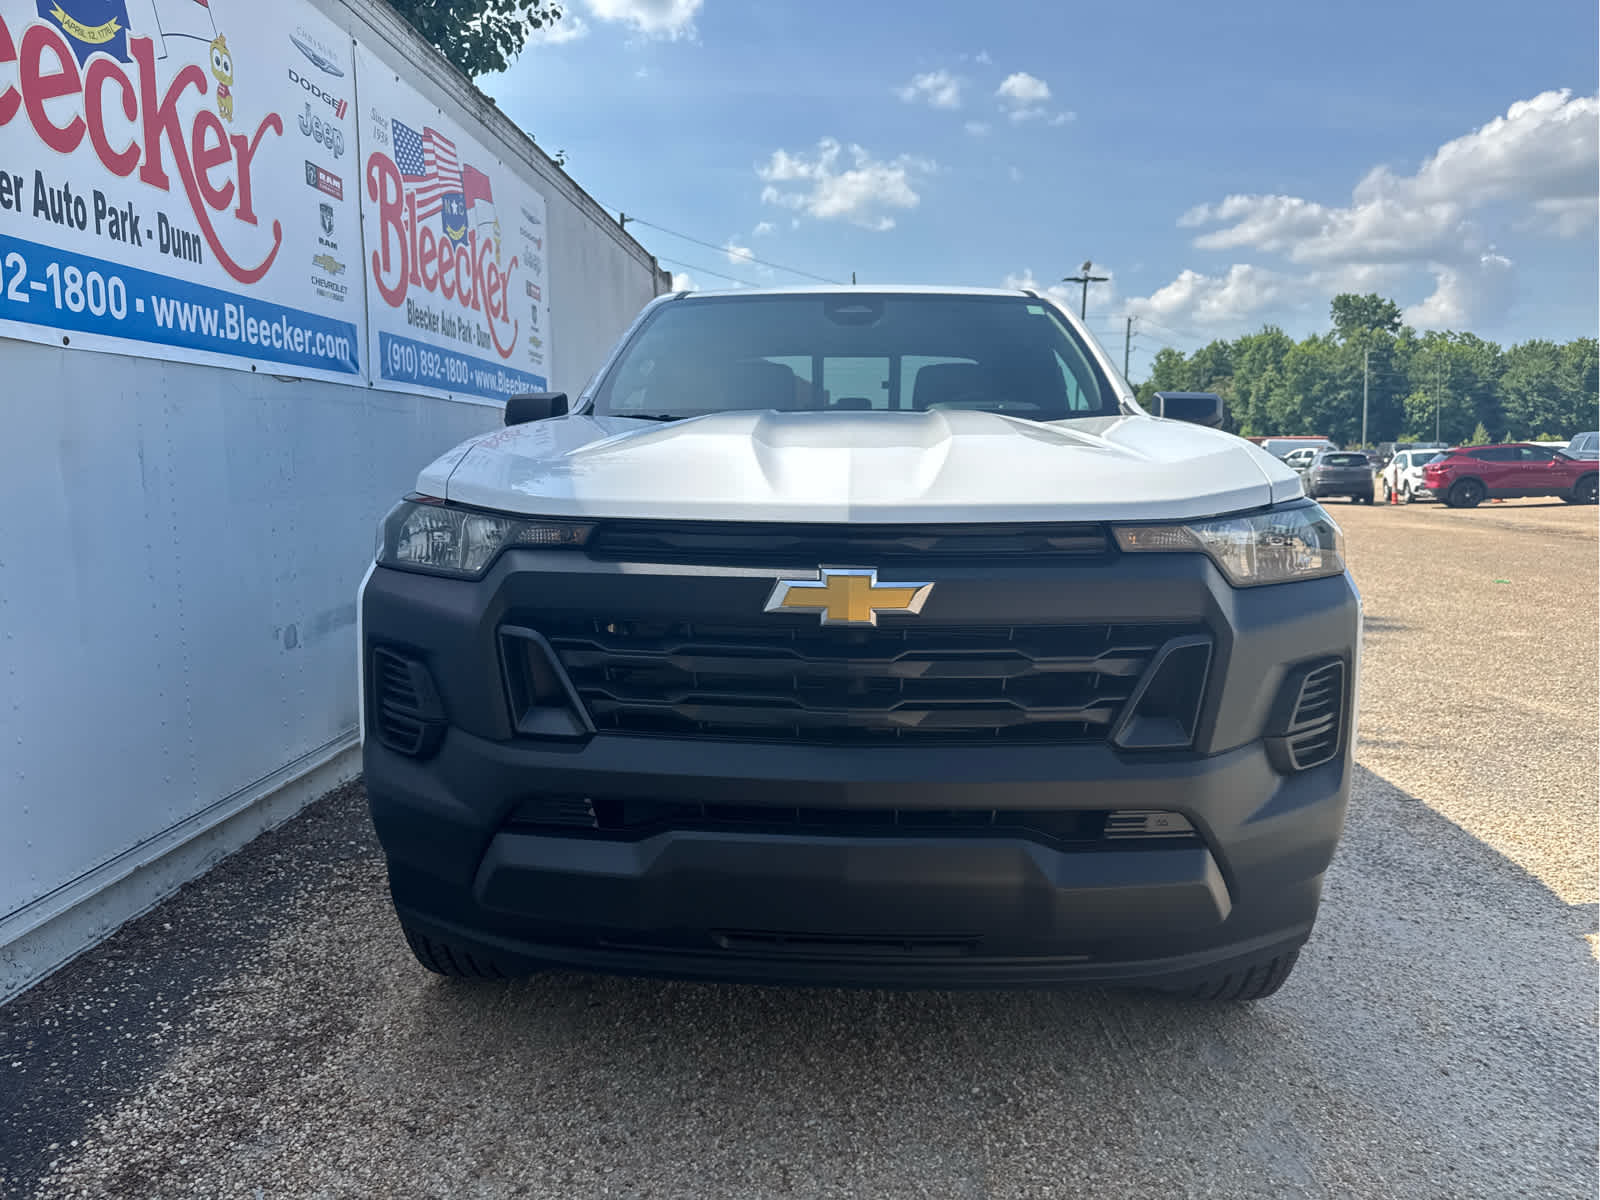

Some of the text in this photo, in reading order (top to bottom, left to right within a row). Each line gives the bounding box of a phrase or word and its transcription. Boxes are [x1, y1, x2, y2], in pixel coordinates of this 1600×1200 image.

[64, 19, 86, 39] APRIL
[289, 69, 339, 111] DODGE
[298, 102, 345, 159] Jeep
[319, 171, 341, 189] RAM
[33, 169, 87, 231] Auto
[93, 189, 142, 247] Park
[157, 211, 202, 264] Dunn
[318, 236, 338, 250] RAM
[367, 151, 518, 359] Bleecker
[0, 252, 350, 361] 2-1800 www.Bleecker.com
[311, 276, 348, 295] CHEVROLET
[407, 297, 440, 333] Bleecker
[441, 310, 457, 340] Auto
[457, 316, 473, 345] Park
[476, 323, 491, 350] Dunn
[387, 338, 417, 379] (910)
[420, 350, 468, 384] 892-1800
